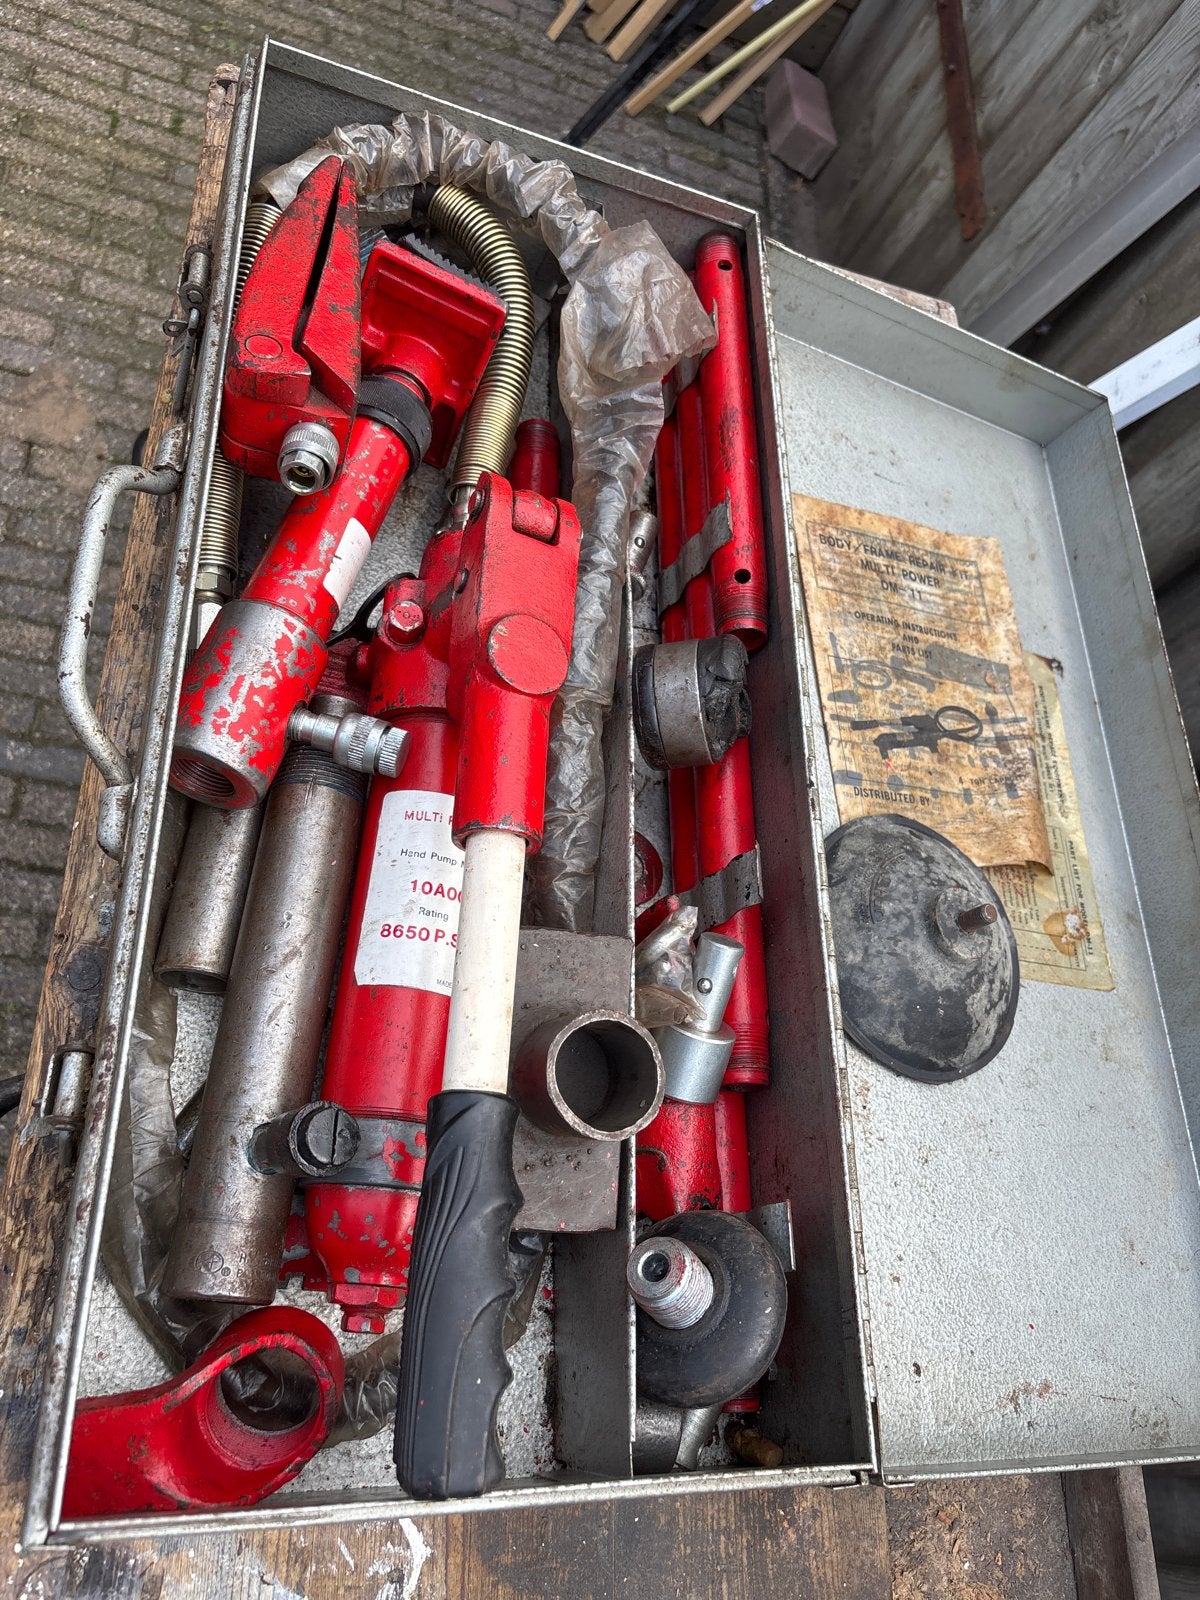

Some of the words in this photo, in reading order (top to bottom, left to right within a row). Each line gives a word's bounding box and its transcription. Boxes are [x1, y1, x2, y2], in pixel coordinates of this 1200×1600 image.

[860, 558, 897, 577] MULTI
[902, 570, 941, 589] POWER
[908, 554, 946, 575] REPAIR
[854, 610, 901, 628] OPERATING
[902, 621, 958, 641] INSTRUCTIONS
[902, 633, 920, 645] AND
[891, 641, 917, 656] PARTS
[918, 648, 932, 660] LIST
[853, 786, 916, 805] DISTRIBUTED
[920, 796, 931, 807] BY
[404, 810, 443, 823] MULTI
[400, 848, 427, 859] Hand
[430, 852, 457, 867] Pump
[1067, 840, 1077, 861] PART
[1072, 864, 1080, 880] LIST
[410, 879, 463, 904] 10A0
[1075, 884, 1084, 900] FOR
[418, 906, 449, 922] Rating
[380, 923, 431, 942] 8650
